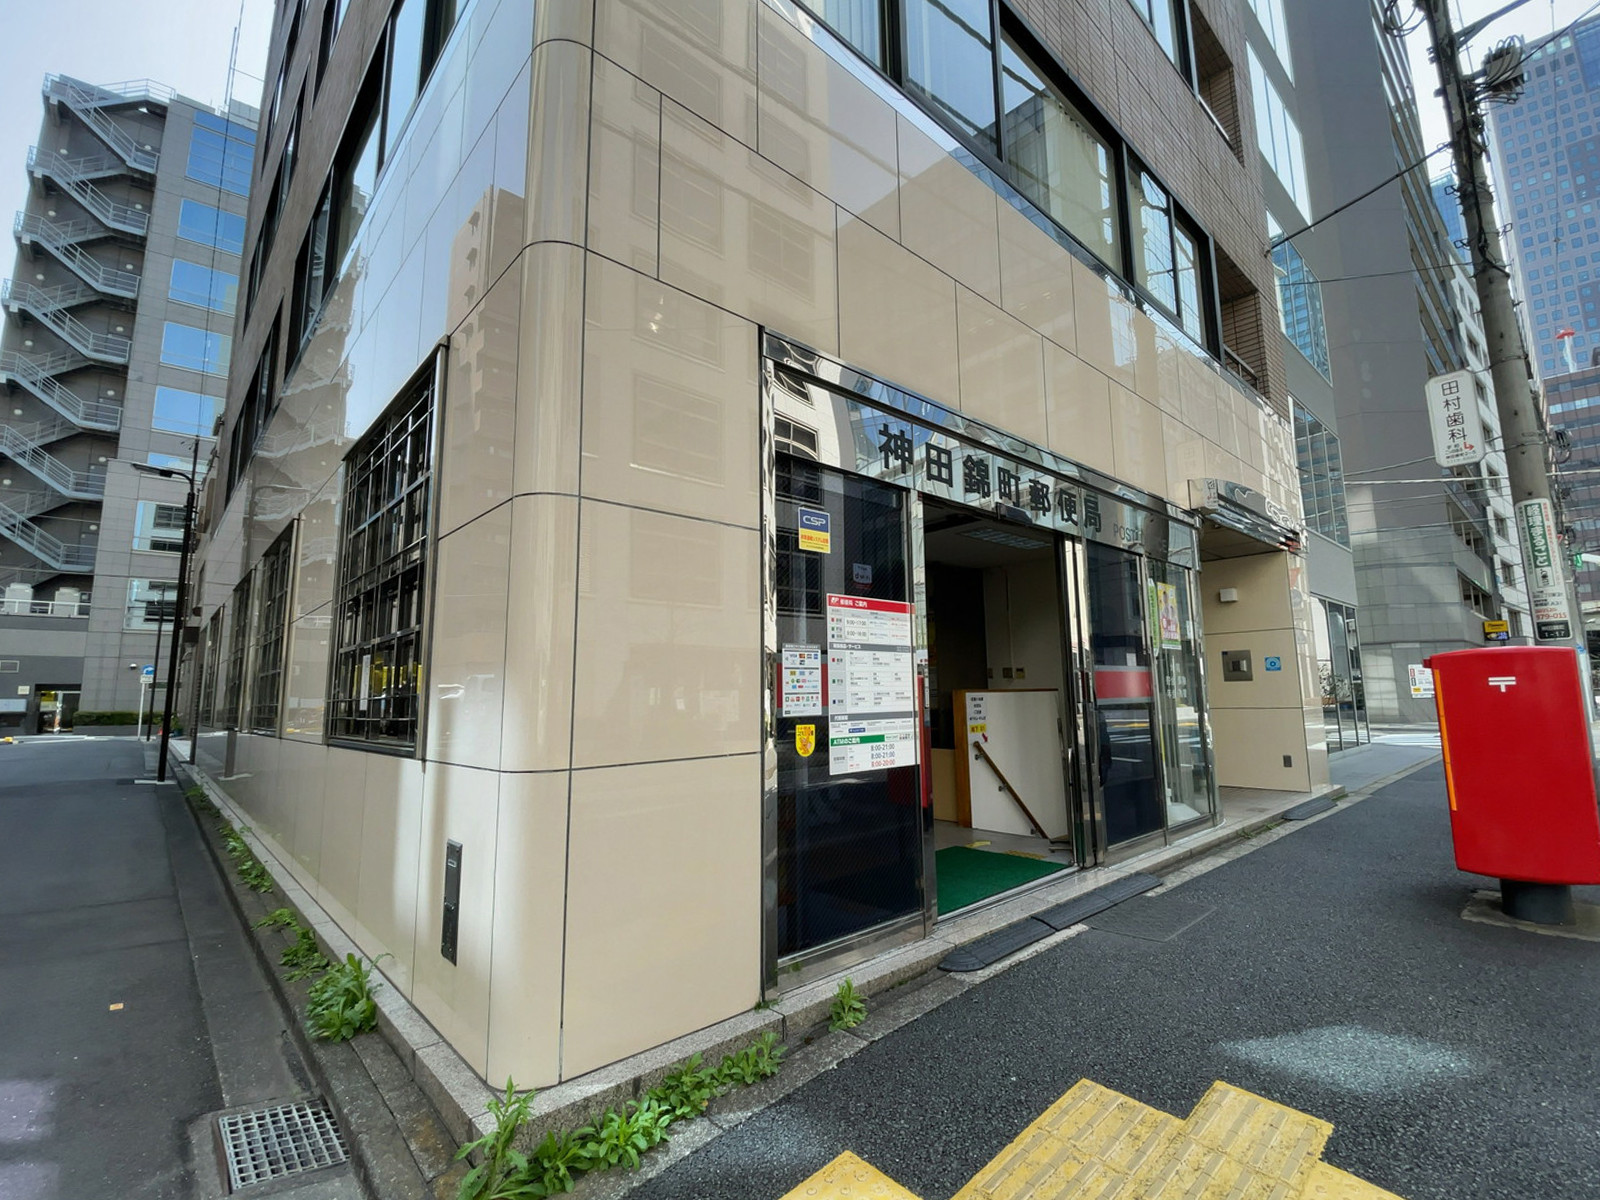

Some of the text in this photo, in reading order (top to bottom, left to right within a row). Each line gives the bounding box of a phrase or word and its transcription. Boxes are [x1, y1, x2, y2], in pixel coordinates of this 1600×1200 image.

[1441, 380, 1467, 443] 田村歯科
[878, 423, 1102, 534] 神田錦町郵便局
[803, 515, 826, 526] CSP
